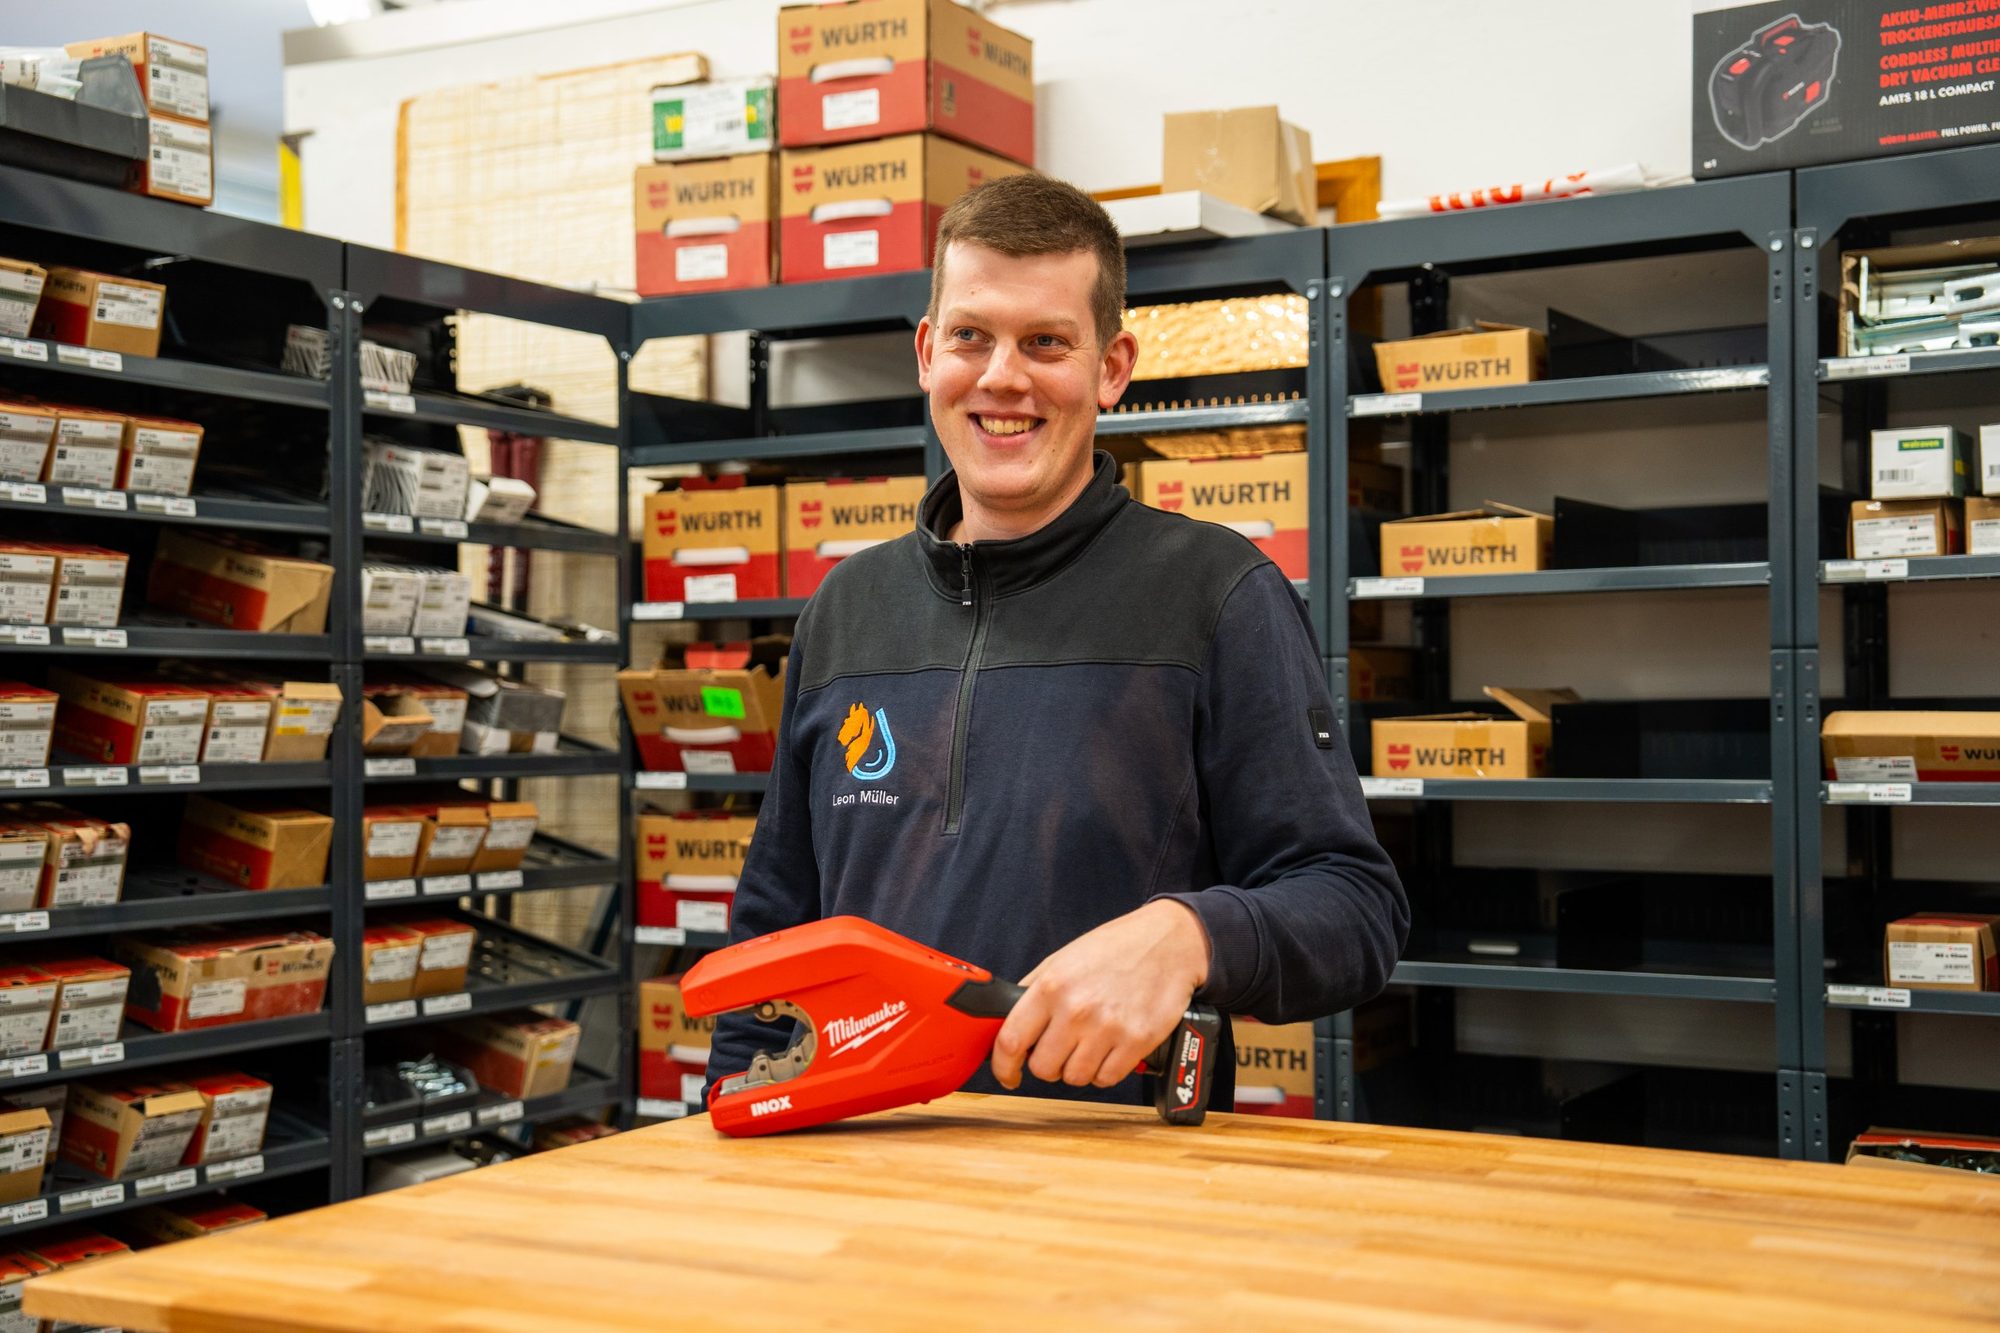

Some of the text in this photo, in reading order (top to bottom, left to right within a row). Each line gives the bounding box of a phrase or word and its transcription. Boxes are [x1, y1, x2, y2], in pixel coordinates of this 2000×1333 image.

[822, 18, 908, 49] WÜRTH
[1880, 47, 1948, 70] CORDLESS
[1880, 71, 1908, 88] DRY
[1911, 61, 1973, 84] VACUUM
[1879, 80, 1995, 106] AMTS 18 L COMPACT
[1941, 127, 1960, 138] FULL
[1959, 123, 1991, 136] POWER.
[824, 160, 908, 189] WÜRTH
[675, 178, 755, 204] WÜRTH
[1422, 358, 1512, 382] WÜRTH
[1191, 480, 1292, 507] WÜRTH
[680, 510, 762, 533] WÜRTH
[832, 503, 915, 526] WÜRTH
[1427, 545, 1518, 567] WÜRTH
[1415, 747, 1506, 767] WÜRTH
[832, 790, 899, 807] Leon Müller
[822, 1000, 907, 1048] Milwaukee
[1235, 1046, 1308, 1071] ÜRTH
[1176, 1074, 1195, 1104] 4.0
[750, 1095, 793, 1117] INOX
